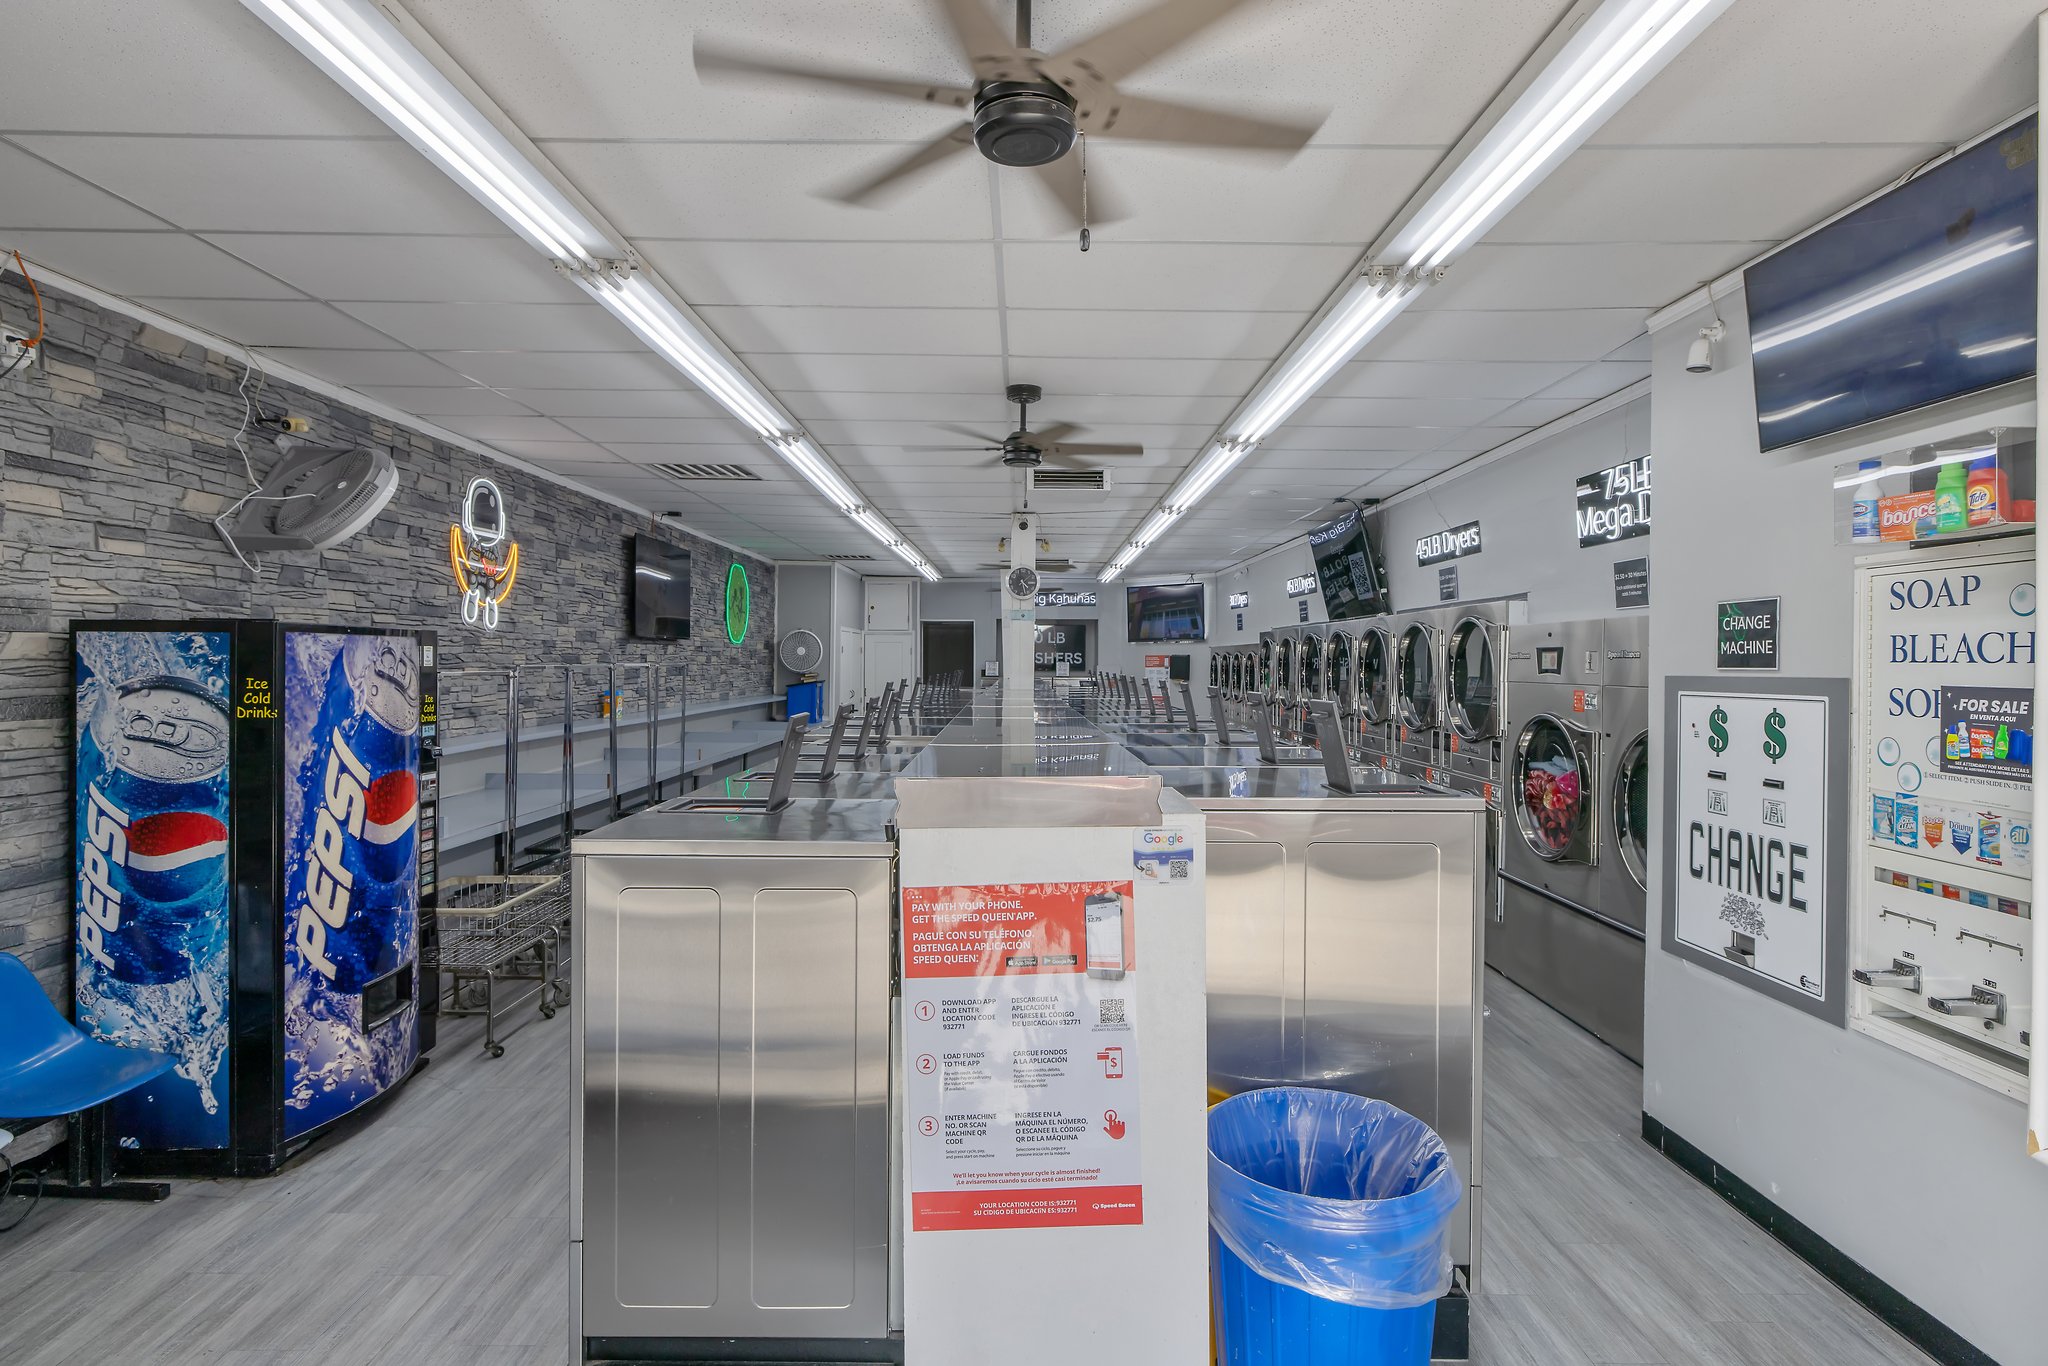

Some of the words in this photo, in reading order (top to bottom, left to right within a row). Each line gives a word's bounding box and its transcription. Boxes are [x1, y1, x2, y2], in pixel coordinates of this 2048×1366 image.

[1970, 492, 1987, 506] Tide
[1576, 502, 1635, 540] Mega
[1883, 501, 1936, 527] bounce
[1416, 535, 1441, 560] 45LB
[1442, 527, 1480, 556] Dryers
[1049, 594, 1096, 604] Kahunas
[1889, 575, 1982, 611] SOAP
[1723, 615, 1771, 631] CHANGE
[1048, 632, 1066, 644] LB
[1721, 640, 1773, 654] MACHINE
[1889, 631, 2036, 664] BLEACH
[246, 678, 268, 689] Ice
[244, 692, 271, 704] Cold
[1959, 699, 1988, 713] FOR
[1990, 700, 2029, 714] SALE
[421, 714, 436, 722] Drinks
[1949, 821, 1973, 834] Downy
[1144, 833, 1183, 845] Google
[2012, 829, 2026, 843] all
[295, 725, 371, 981] PEPSI
[1689, 820, 1809, 913] CHANGE
[79, 780, 130, 971] PEPSI
[912, 904, 930, 912] PAY
[932, 903, 956, 911] WITH
[959, 902, 985, 910] YOUR
[988, 901, 1023, 909] PHONE.
[952, 914, 979, 922] SPEED
[913, 932, 944, 941] PAGUE
[946, 932, 967, 940] CON
[984, 928, 1034, 938] TELÉFONO.
[913, 943, 958, 952] OBTENGA
[974, 940, 1030, 950] APLICACIÓN
